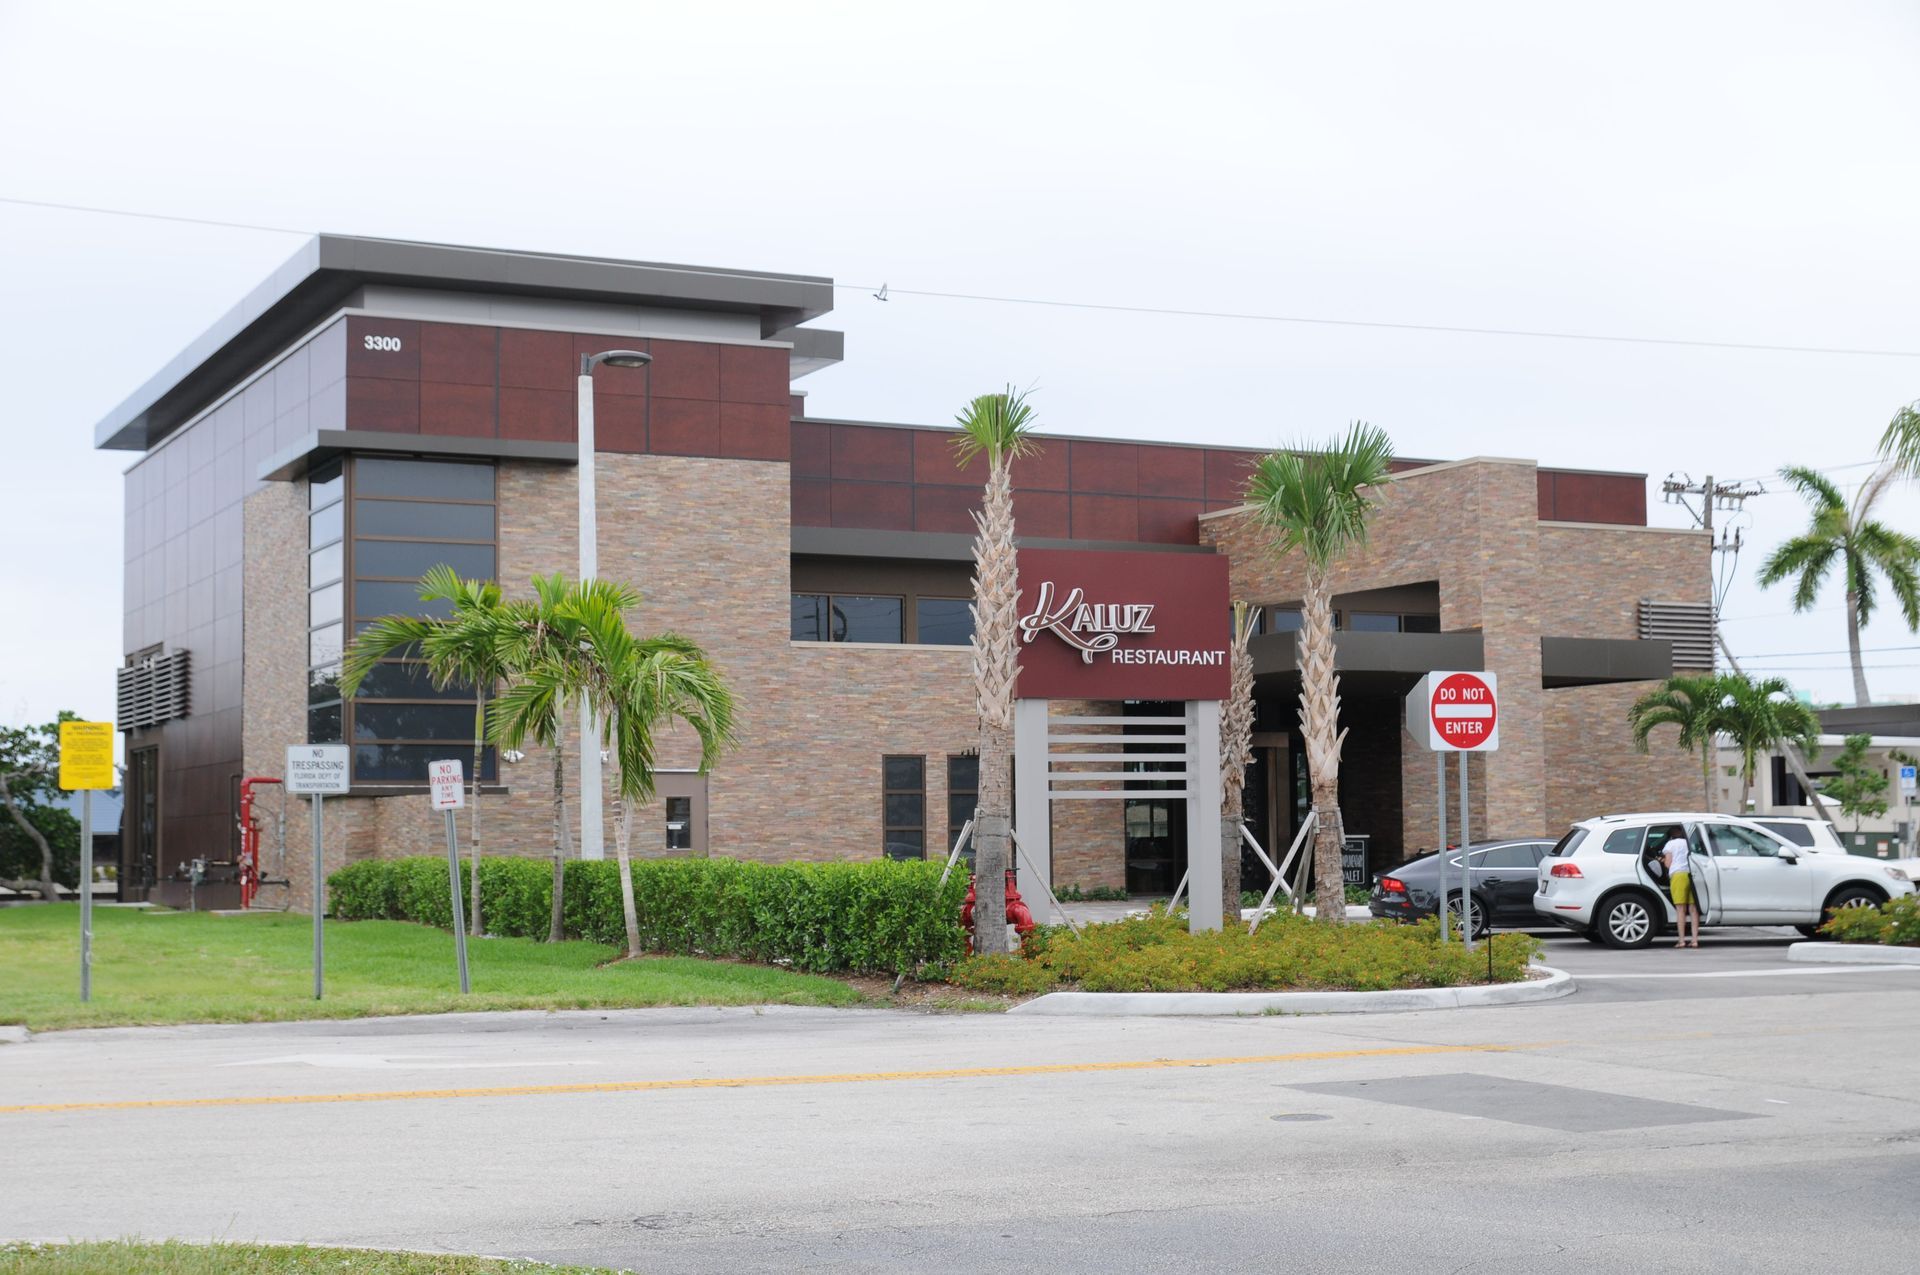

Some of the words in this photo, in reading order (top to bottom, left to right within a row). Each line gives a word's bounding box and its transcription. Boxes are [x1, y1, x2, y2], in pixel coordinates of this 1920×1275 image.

[364, 335, 401, 351] 3300
[1112, 649, 1226, 665] RESTAURANT
[1440, 687, 1456, 700] DO
[1463, 687, 1485, 700] NOT
[1445, 721, 1483, 734] ENTER
[312, 749, 324, 758] NO
[292, 760, 344, 770] TRESPASSING
[440, 764, 452, 774] NO
[431, 775, 463, 784] PARKING
